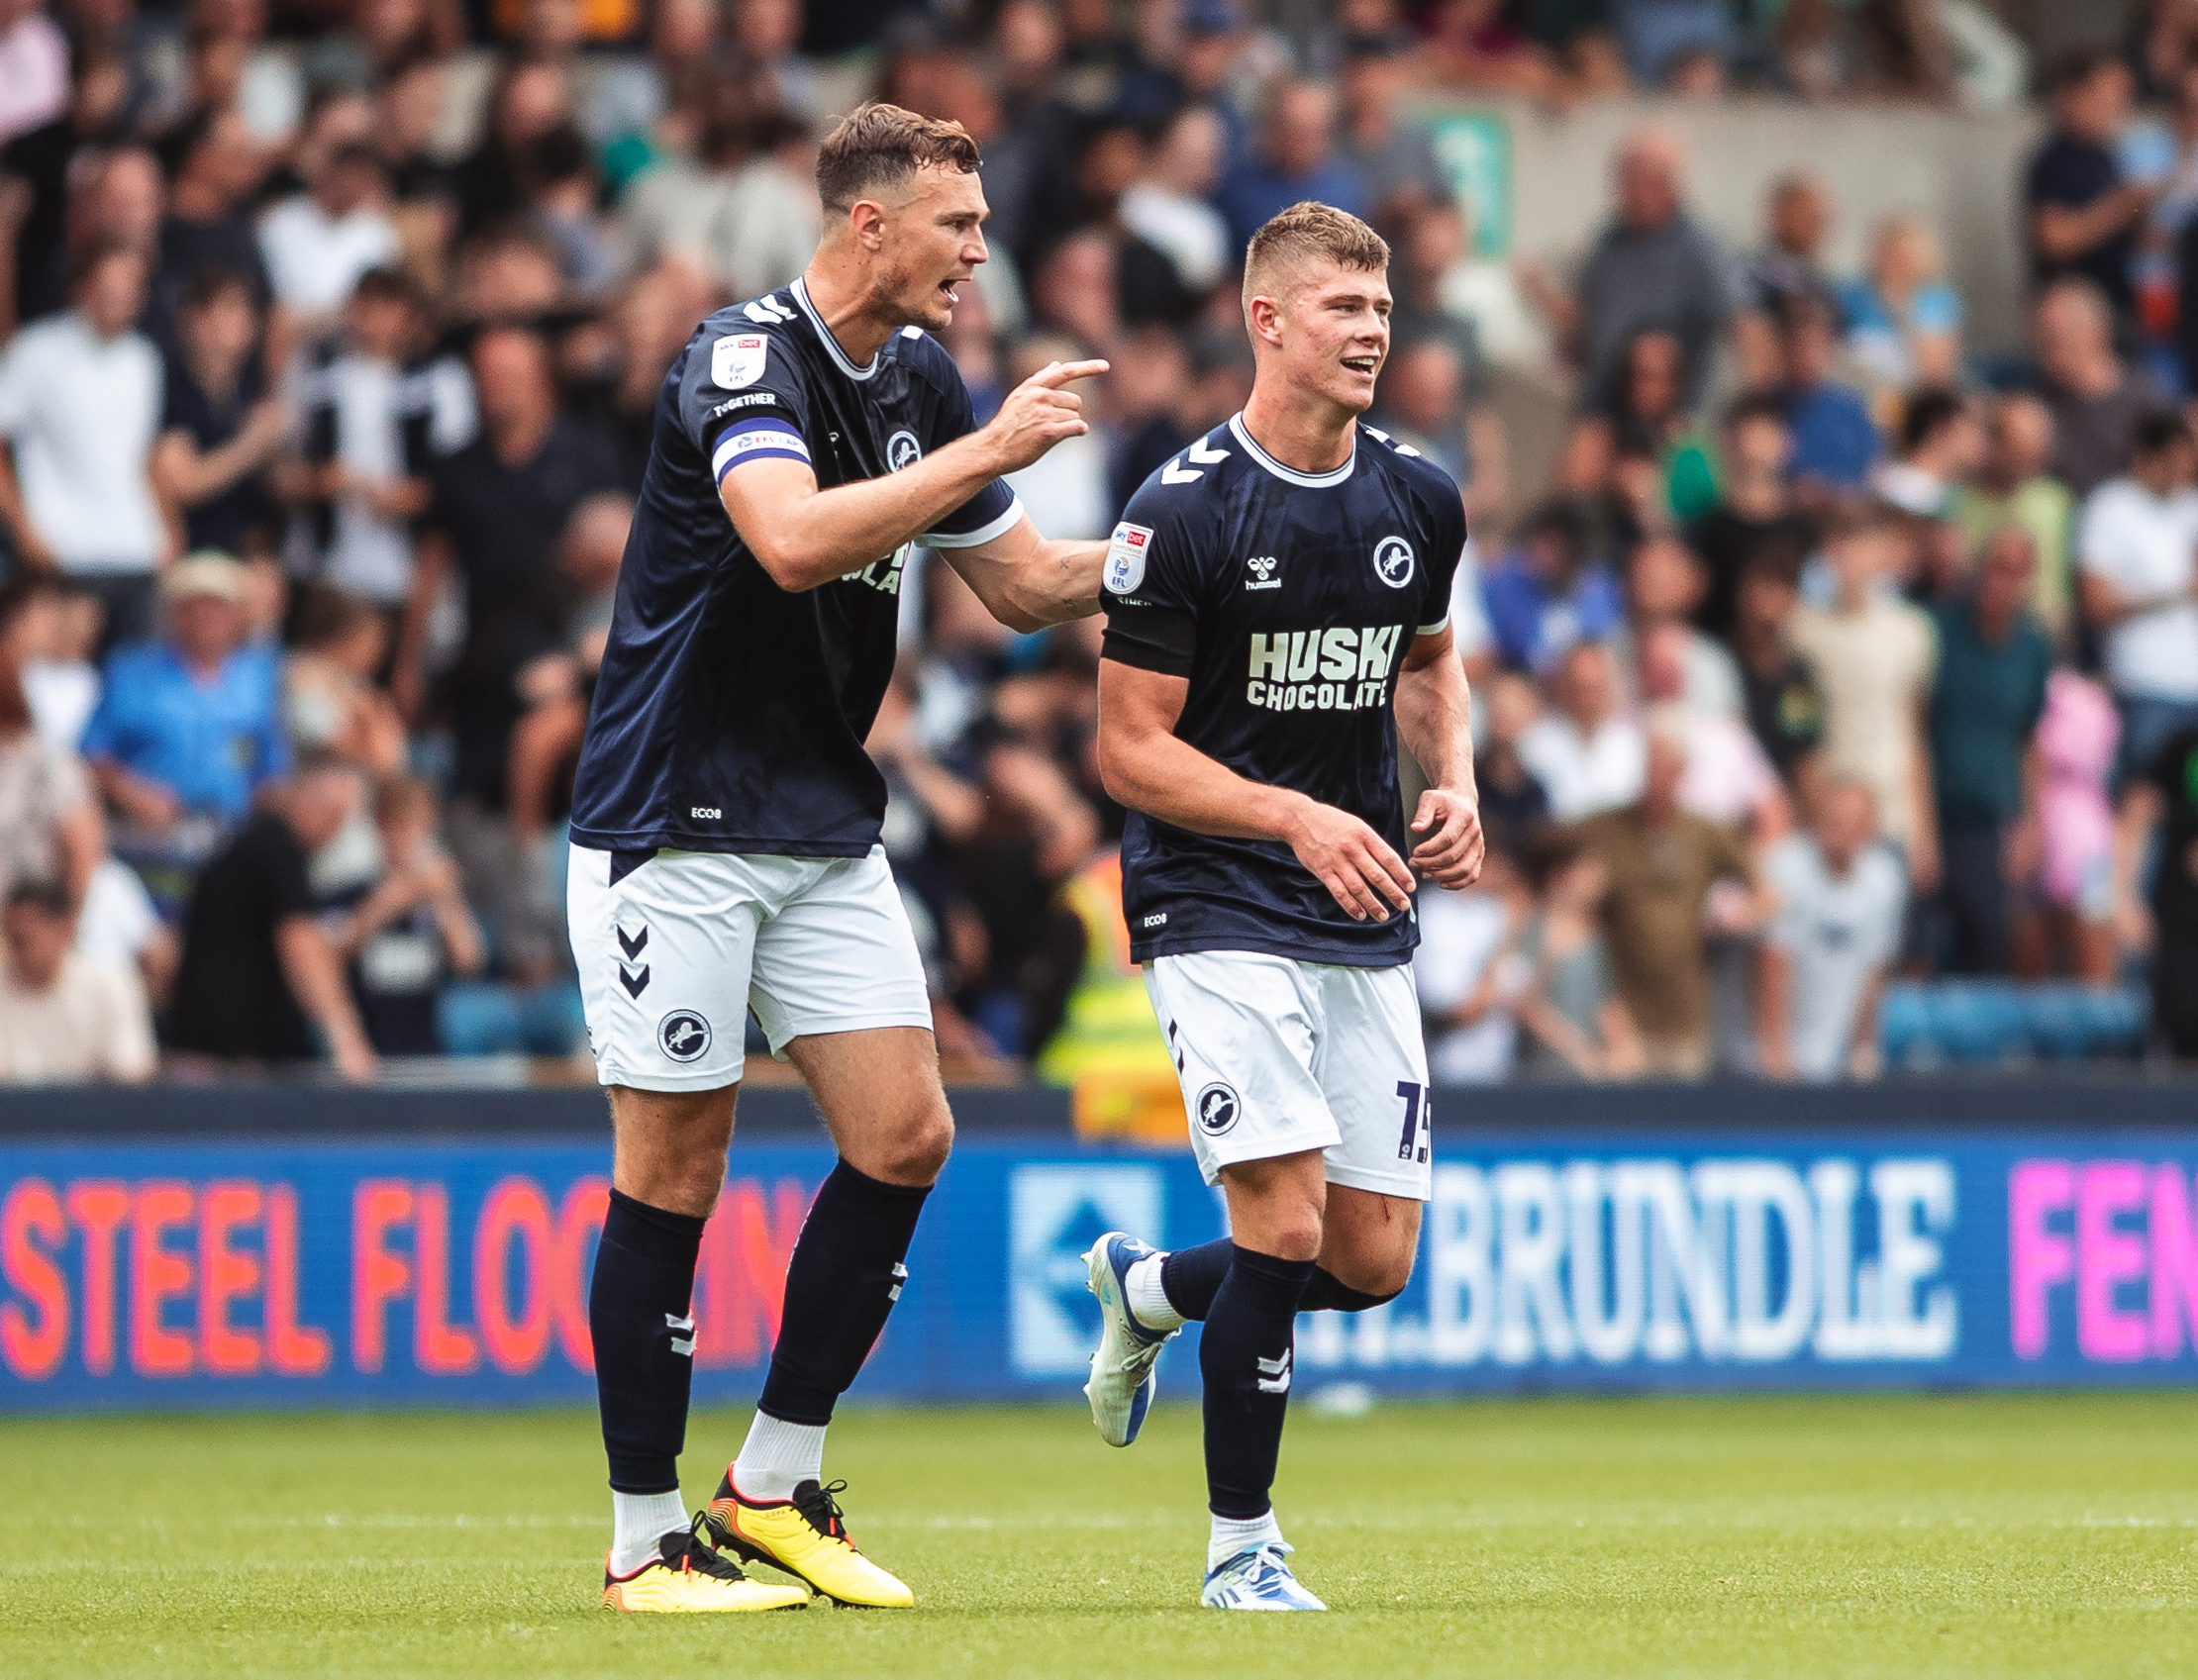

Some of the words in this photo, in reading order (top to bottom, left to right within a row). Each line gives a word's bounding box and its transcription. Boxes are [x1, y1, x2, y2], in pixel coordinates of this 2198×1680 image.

[1112, 576, 1126, 587] EFL
[1245, 577, 1282, 591] hummel
[1249, 624, 1403, 683] HUSKI
[2, 1177, 329, 1379] STEEL
